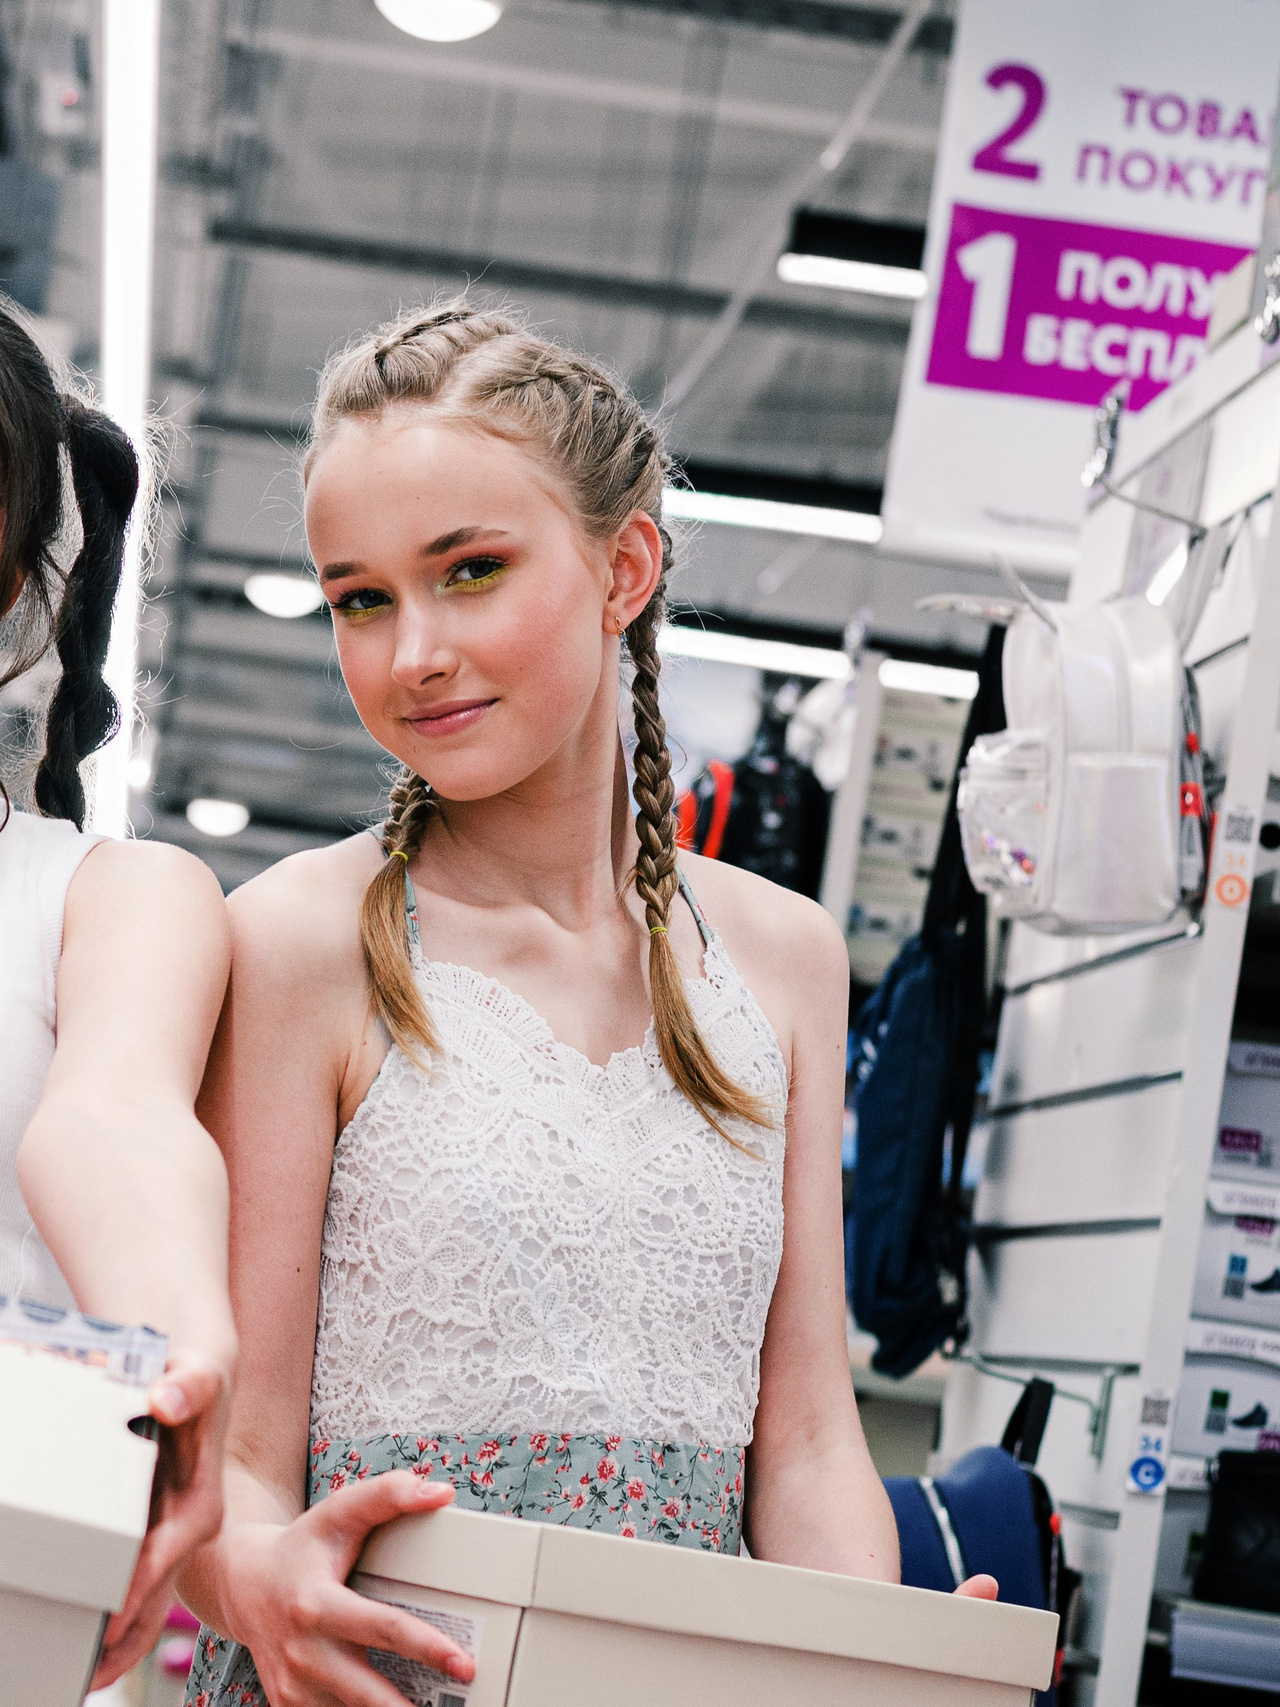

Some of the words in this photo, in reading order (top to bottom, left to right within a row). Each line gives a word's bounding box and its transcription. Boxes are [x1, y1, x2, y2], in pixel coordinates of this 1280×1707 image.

[972, 62, 1048, 182] 2
[1117, 84, 1270, 146] ТОВА
[956, 232, 1017, 361] 1
[1055, 249, 1223, 321] ПОЛУ
